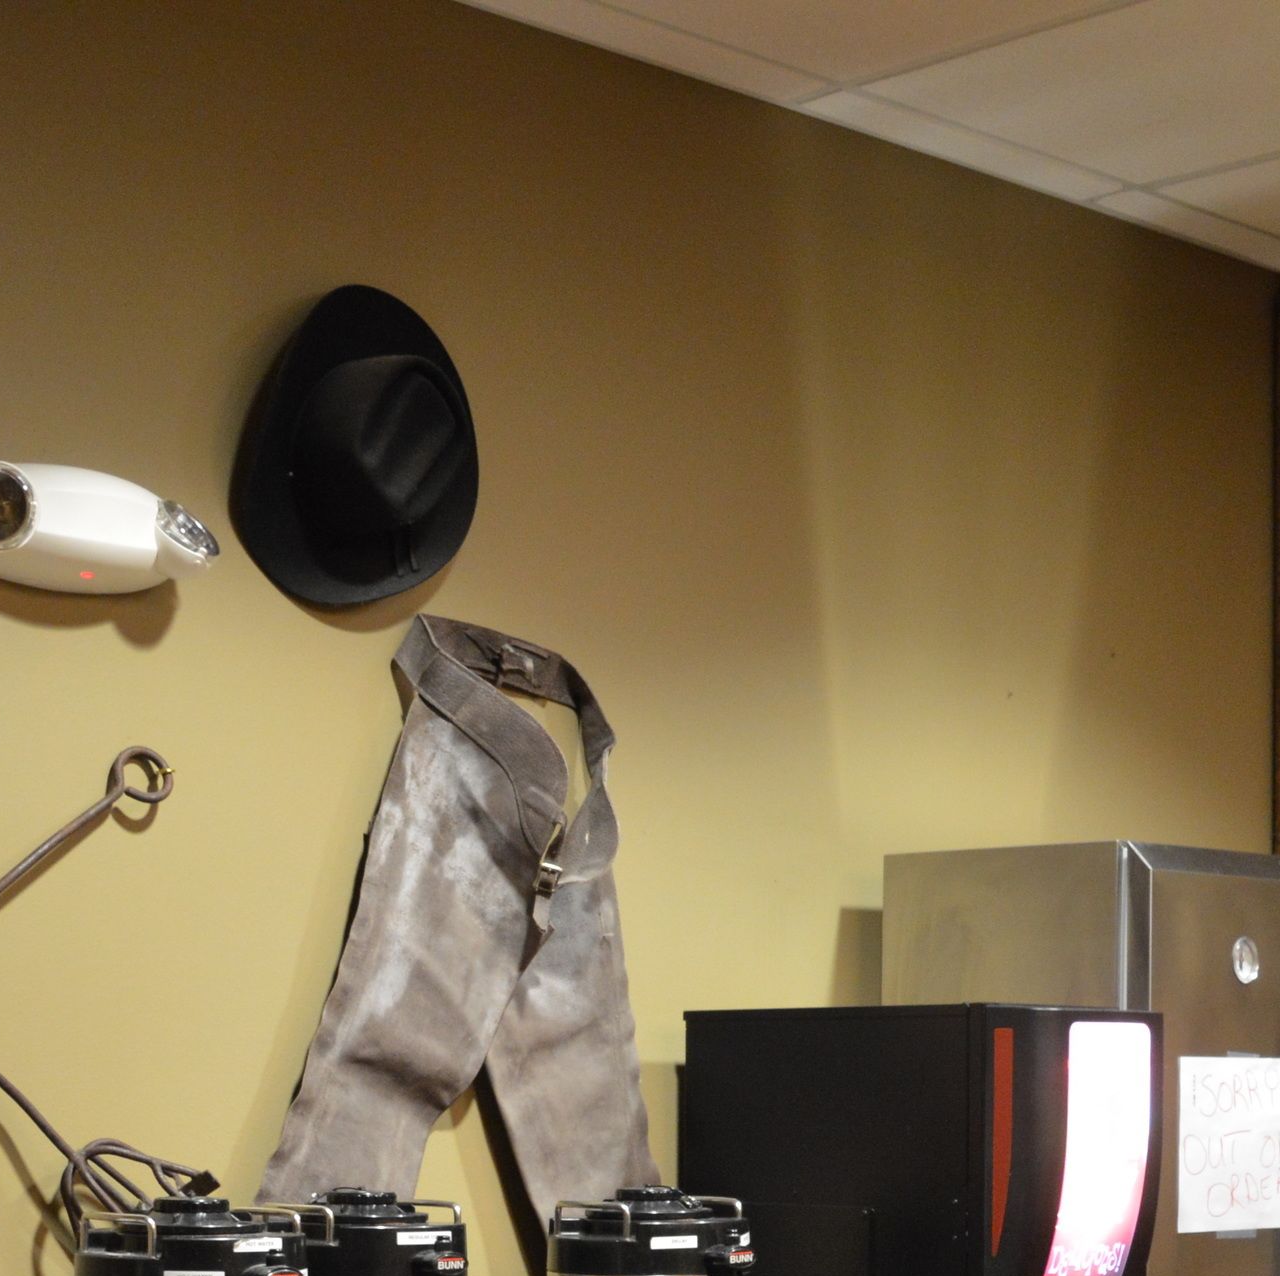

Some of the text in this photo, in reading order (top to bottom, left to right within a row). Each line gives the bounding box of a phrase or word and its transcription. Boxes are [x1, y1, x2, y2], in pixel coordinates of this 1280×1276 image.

[1199, 1066, 1280, 1118] SORRY
[1183, 1129, 1252, 1176] OUT
[437, 1261, 464, 1270] BUNN
[729, 1254, 754, 1264] BUNN
